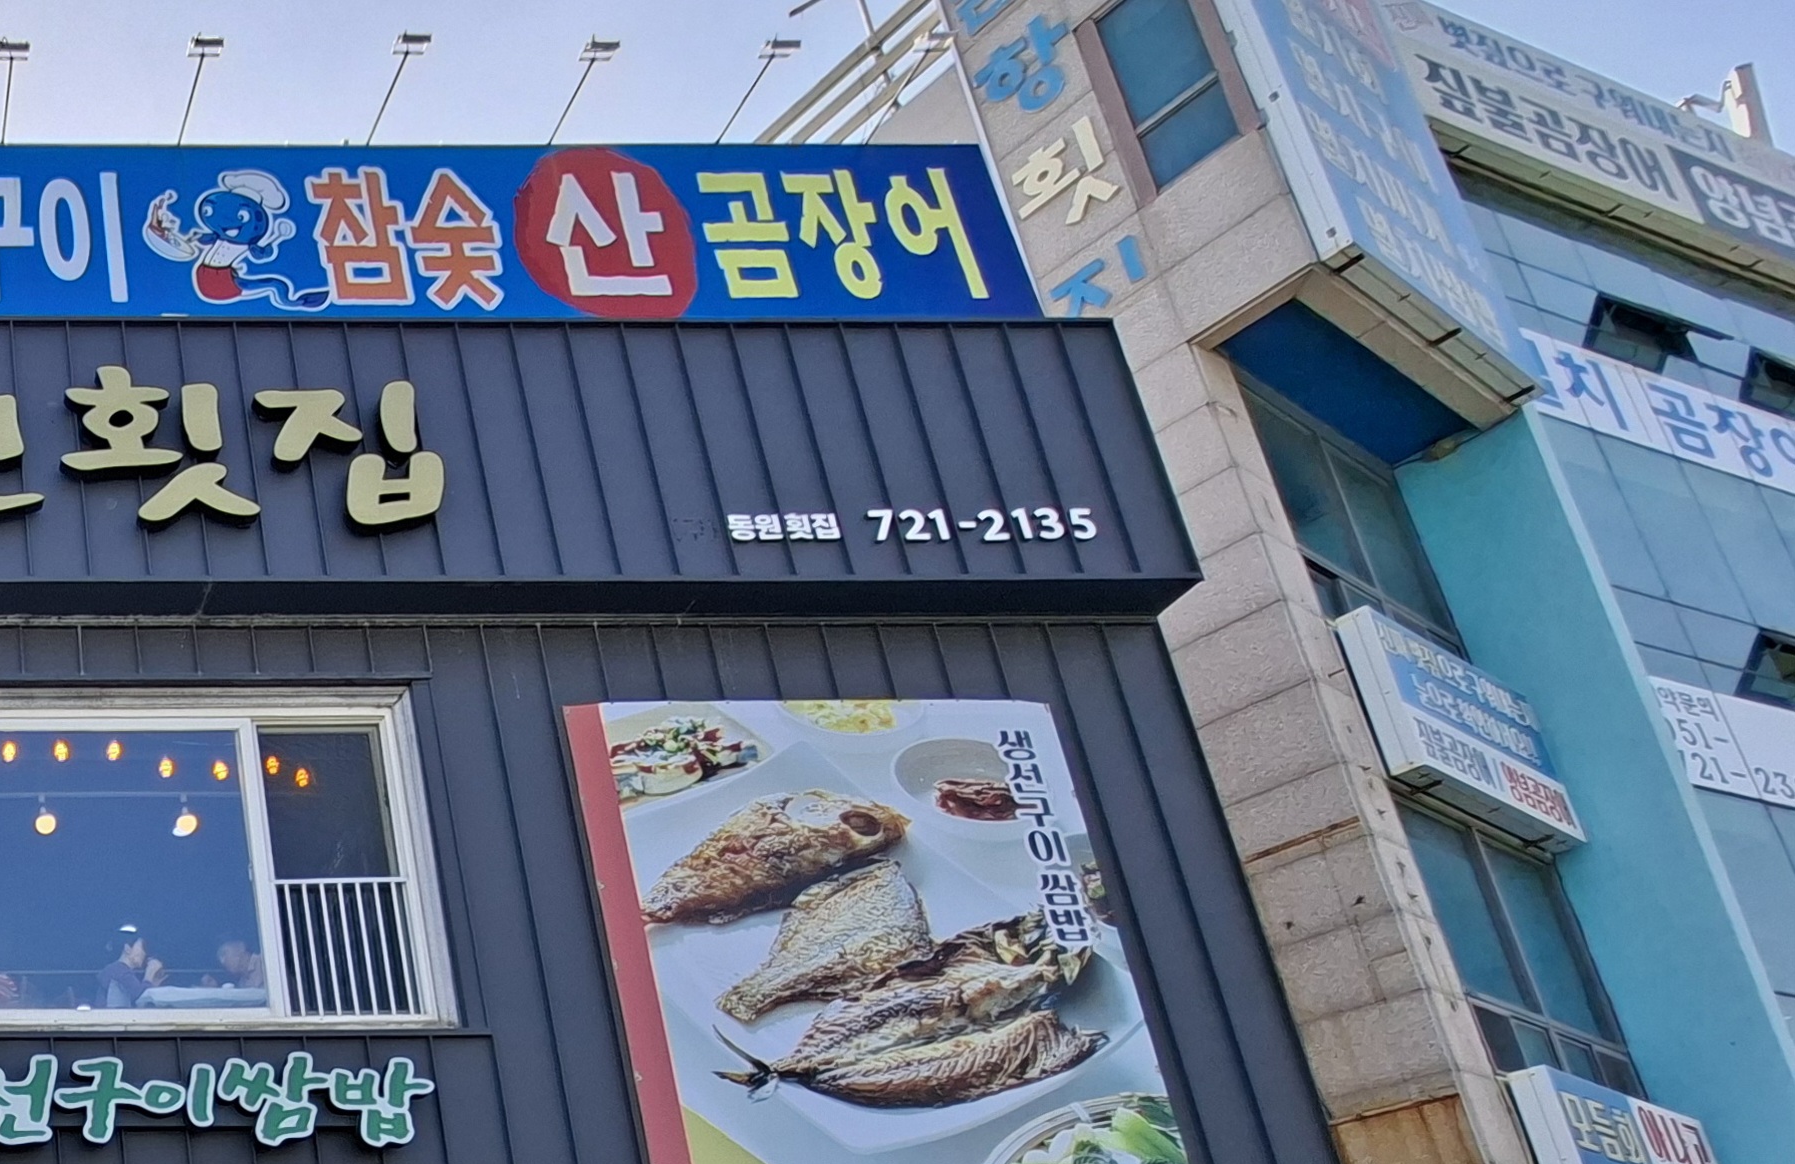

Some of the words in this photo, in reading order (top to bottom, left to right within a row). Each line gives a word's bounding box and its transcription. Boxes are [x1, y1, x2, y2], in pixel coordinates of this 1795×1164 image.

[1415, 54, 1677, 201] 짚불곰장어
[1688, 164, 1795, 250] 양념
[305, 166, 504, 310] 참숯
[546, 171, 673, 296] 산
[696, 168, 990, 300] 곰장어
[726, 511, 842, 543] 동원횟집
[866, 507, 1098, 543] 721-2135
[1652, 685, 1720, 722] 약문의
